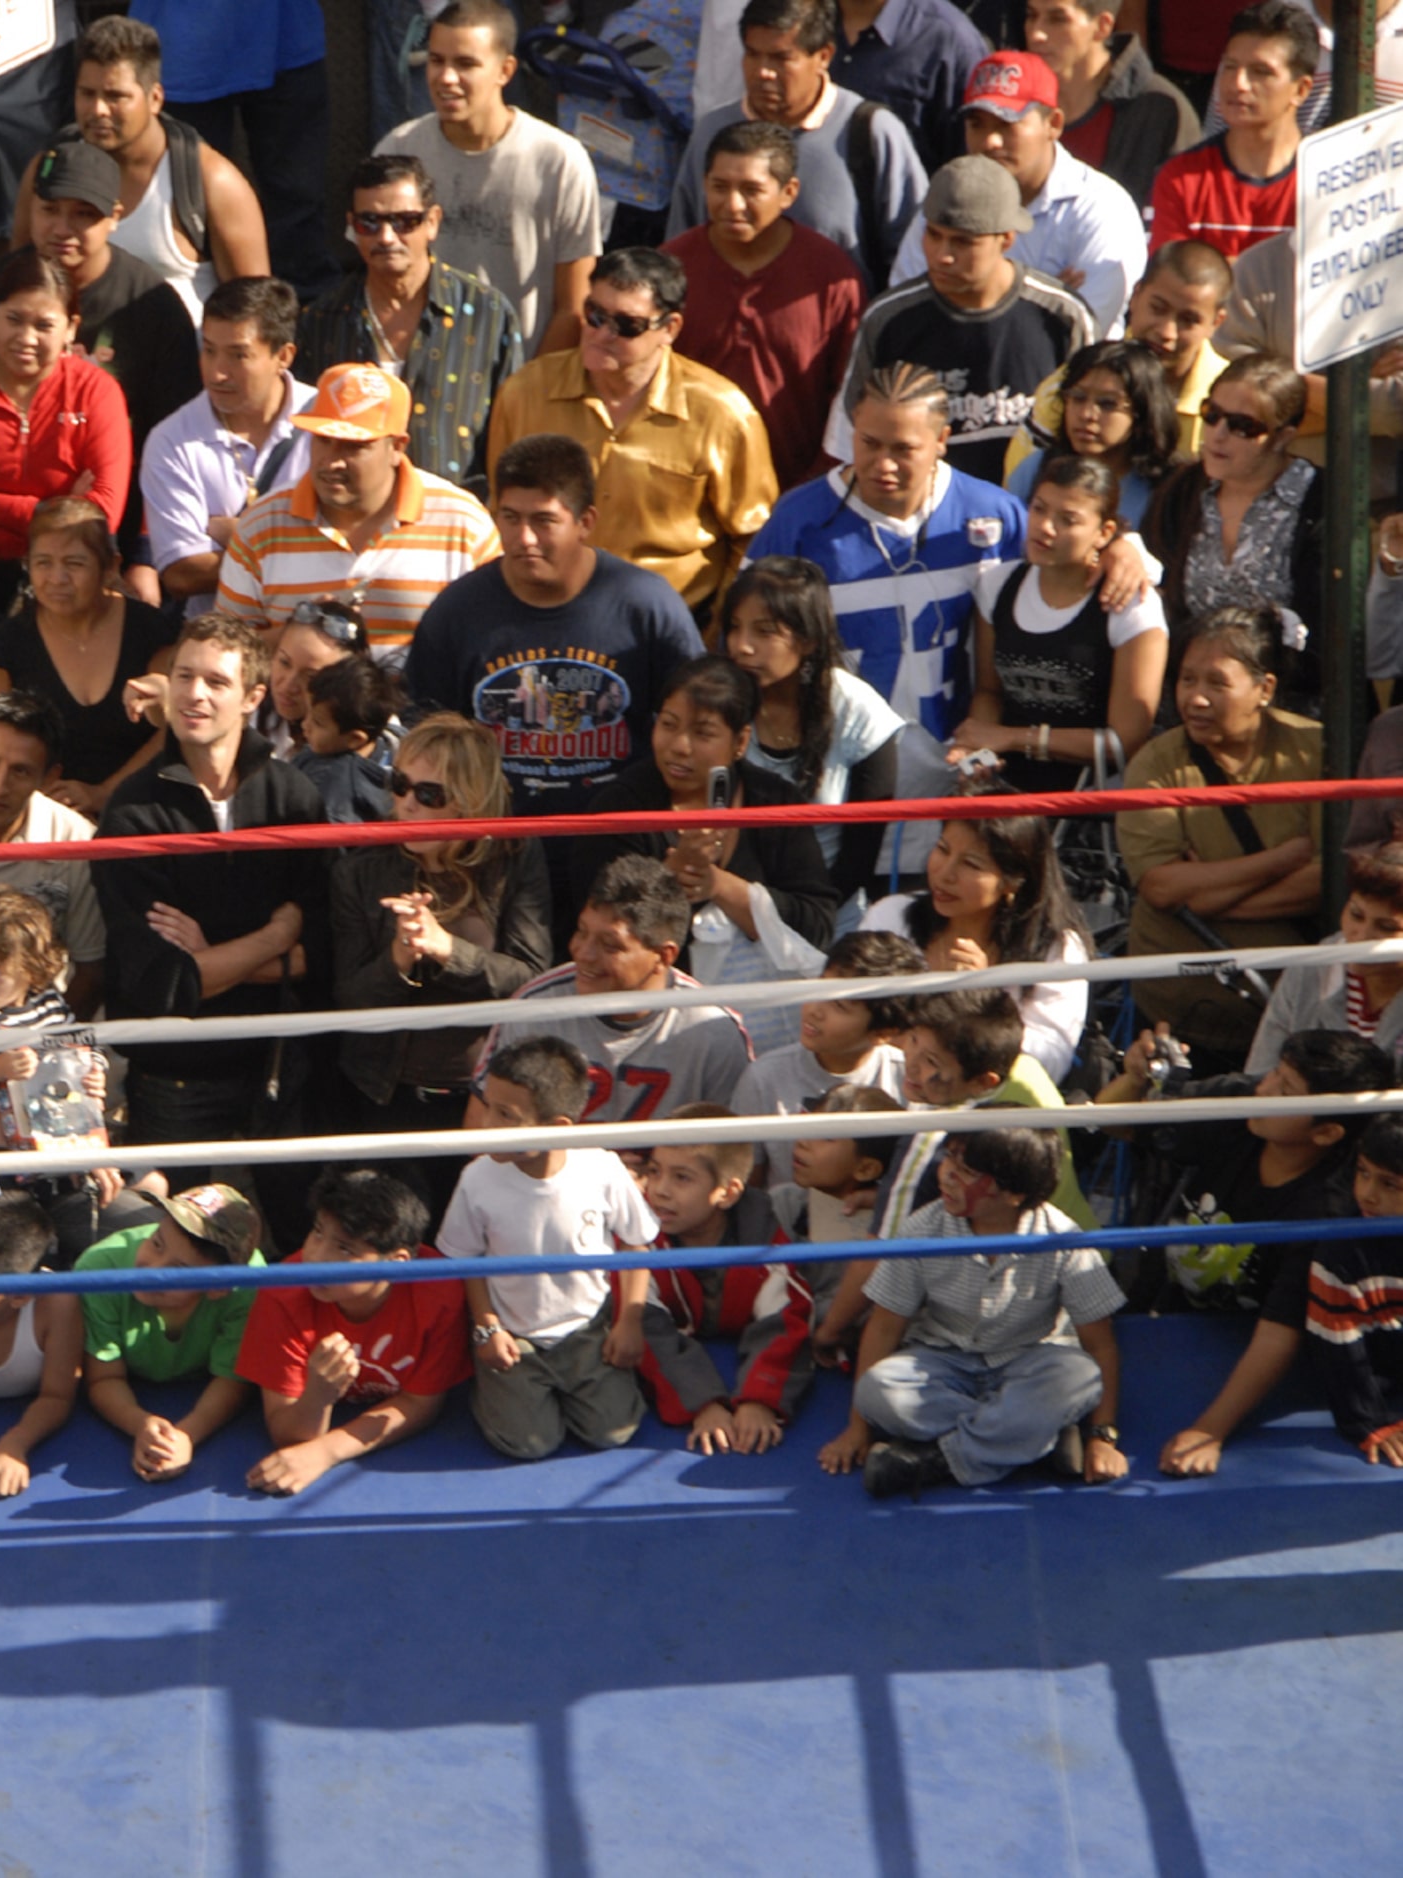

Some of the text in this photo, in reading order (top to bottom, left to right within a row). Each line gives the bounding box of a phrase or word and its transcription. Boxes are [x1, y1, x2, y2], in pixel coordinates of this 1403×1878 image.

[1328, 188, 1401, 237] POSTAL
[1340, 278, 1388, 320] ONLY
[947, 385, 1036, 431] ngeles
[556, 667, 603, 691] 2007
